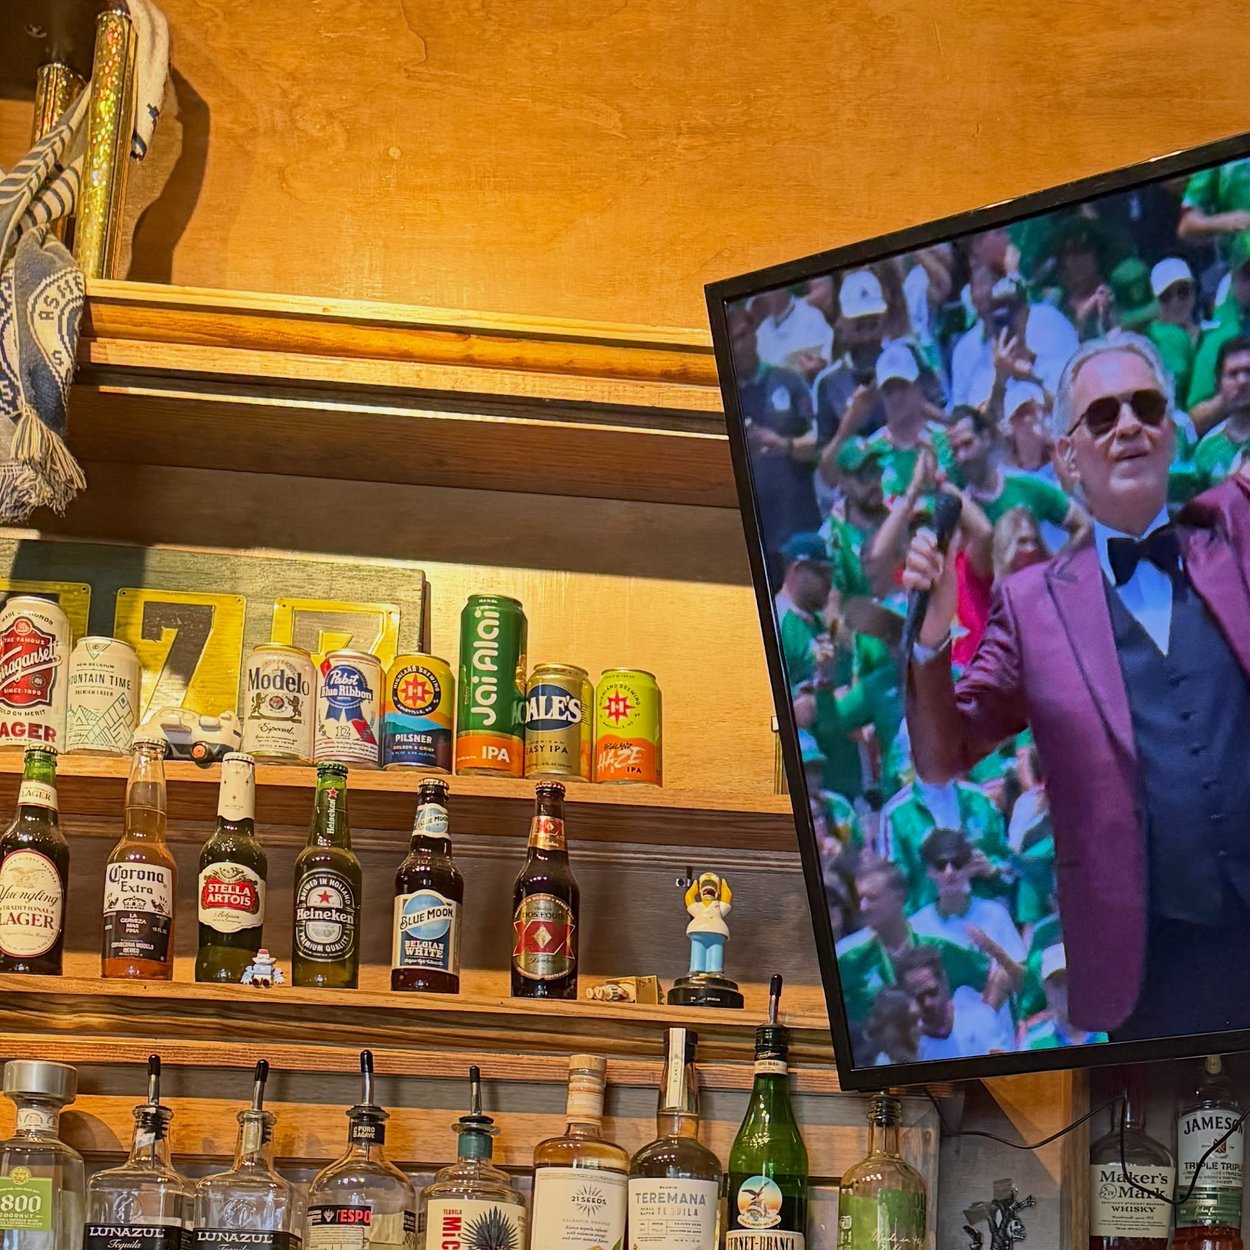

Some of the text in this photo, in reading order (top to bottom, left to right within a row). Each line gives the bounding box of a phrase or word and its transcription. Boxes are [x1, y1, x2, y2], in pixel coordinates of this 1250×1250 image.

[16, 637, 45, 645] FAMOUS
[471, 608, 501, 726] Jai Alai
[109, 675, 131, 690] TIME
[248, 667, 310, 697] Modelo
[331, 670, 359, 686] Pabst
[322, 686, 373, 701] Blue Ribbon
[525, 695, 582, 725] DALE'S
[0, 721, 57, 743] AGER
[395, 734, 433, 744] PILSNER
[481, 746, 511, 763] IPA
[549, 746, 569, 755] IPA
[627, 766, 642, 774] IPA
[22, 790, 51, 801] LAGER
[327, 798, 336, 835] Heineken
[109, 865, 165, 885] Corona
[120, 881, 154, 895] Extra
[208, 884, 251, 896] STELLA
[207, 895, 251, 906] ARTOIS
[0, 913, 55, 930] LAGER
[296, 909, 355, 924] Heineken
[400, 907, 454, 931] BLUE MOON
[404, 940, 445, 951] BELGIAN
[404, 948, 444, 959] WHITE
[1100, 1170, 1168, 1185] Maker's
[635, 1193, 706, 1205] TEREMANA
[1118, 1186, 1166, 1200] Mark
[0, 1194, 41, 1214] 800
[89, 1227, 164, 1238] LUNAZUL
[198, 1231, 272, 1243] LUNAZUL
[107, 1240, 141, 1250] Tequila
